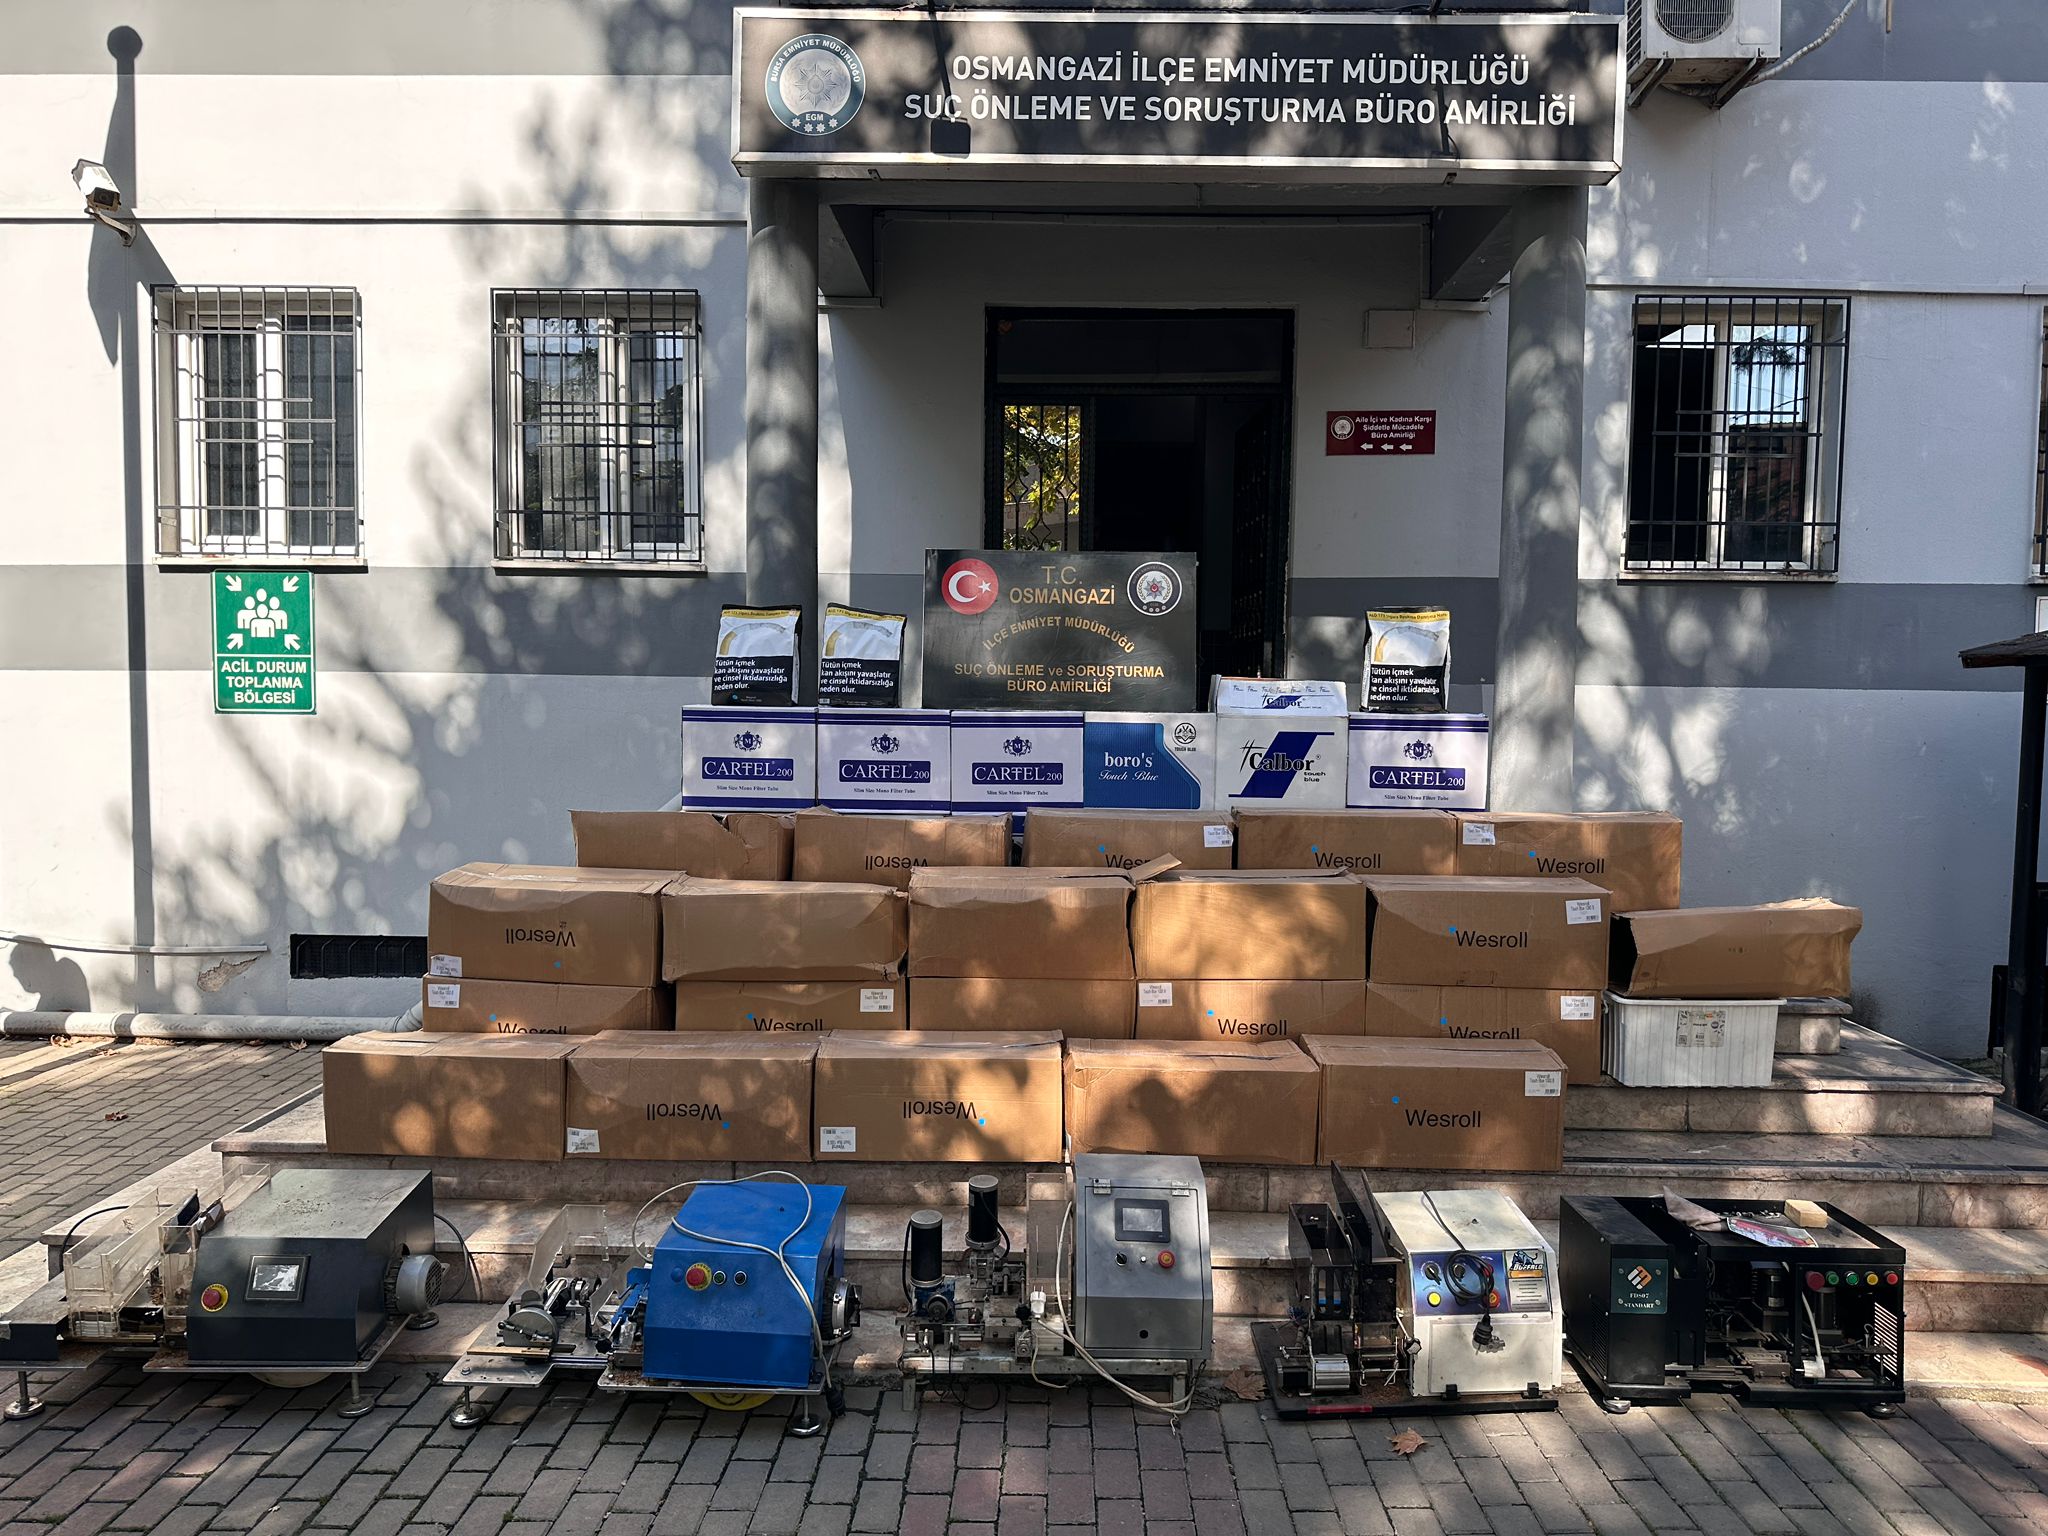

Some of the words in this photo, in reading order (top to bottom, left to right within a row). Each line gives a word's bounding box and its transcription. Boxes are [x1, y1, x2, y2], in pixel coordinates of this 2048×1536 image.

[770, 58, 785, 82] BURSA
[783, 39, 820, 58] EMNİYET
[952, 51, 1121, 81] OSMANGAZİ
[1132, 51, 1195, 85] İLÇE
[1205, 52, 1334, 83] EMNİYET
[1342, 53, 1530, 85] MÜDÜRLÜĞÜ
[904, 94, 963, 123] SUÇ
[971, 89, 1092, 120] ÖNLEME
[1100, 96, 1136, 120] VE
[1145, 96, 1346, 126] SORUŞTURMA
[1355, 93, 1435, 124] BÜRO
[1444, 93, 1576, 126] AMİRLİĞİ
[805, 113, 824, 121] EGM
[1041, 565, 1083, 585] T.C.
[1009, 585, 1116, 605] OSMANGAZİ
[982, 628, 1009, 650] İLÇE
[1010, 616, 1061, 635] EMNİYET
[1065, 616, 1135, 653] MÜDÜRLÜĞÜ
[221, 658, 253, 673] ACİL
[256, 661, 307, 673] DURUM
[714, 666, 726, 674] kan
[751, 667, 785, 675] yavaşlatır
[841, 661, 862, 669] içmek
[954, 663, 982, 678] SUÇ
[986, 661, 1044, 676] ÖNLEME
[1048, 667, 1063, 676] ve
[1067, 664, 1165, 680] SORUŞTURMA
[1392, 668, 1414, 677] içmek
[225, 676, 303, 688] TOPLANMA
[742, 675, 787, 683] iktidarsızlığa
[849, 678, 894, 687] iktidarsızlığa
[857, 671, 891, 679] yavaşlatır
[1007, 677, 1047, 692] BÜRO
[1050, 678, 1111, 693] AMİRLİĞİ
[234, 689, 296, 704] BÖLGESİ
[1104, 751, 1153, 767] boro's
[776, 768, 793, 777] 200
[913, 770, 930, 779] 200
[1046, 772, 1062, 781] 200
[1098, 770, 1128, 781] Touch
[1133, 771, 1159, 781] Blue
[1447, 777, 1464, 786] 200
[865, 855, 928, 870] Wesroll
[1315, 852, 1381, 868] Wesroll
[1536, 857, 1605, 874] Wesroll
[506, 928, 576, 947] Wesroll
[1455, 930, 1528, 948] Wesroll
[753, 1018, 823, 1031] Wesroll
[1217, 1019, 1288, 1036] Wesroll
[646, 1103, 722, 1121] Wesroll
[903, 1101, 977, 1119] Wesroll
[1405, 1109, 1481, 1128] Wesroll
